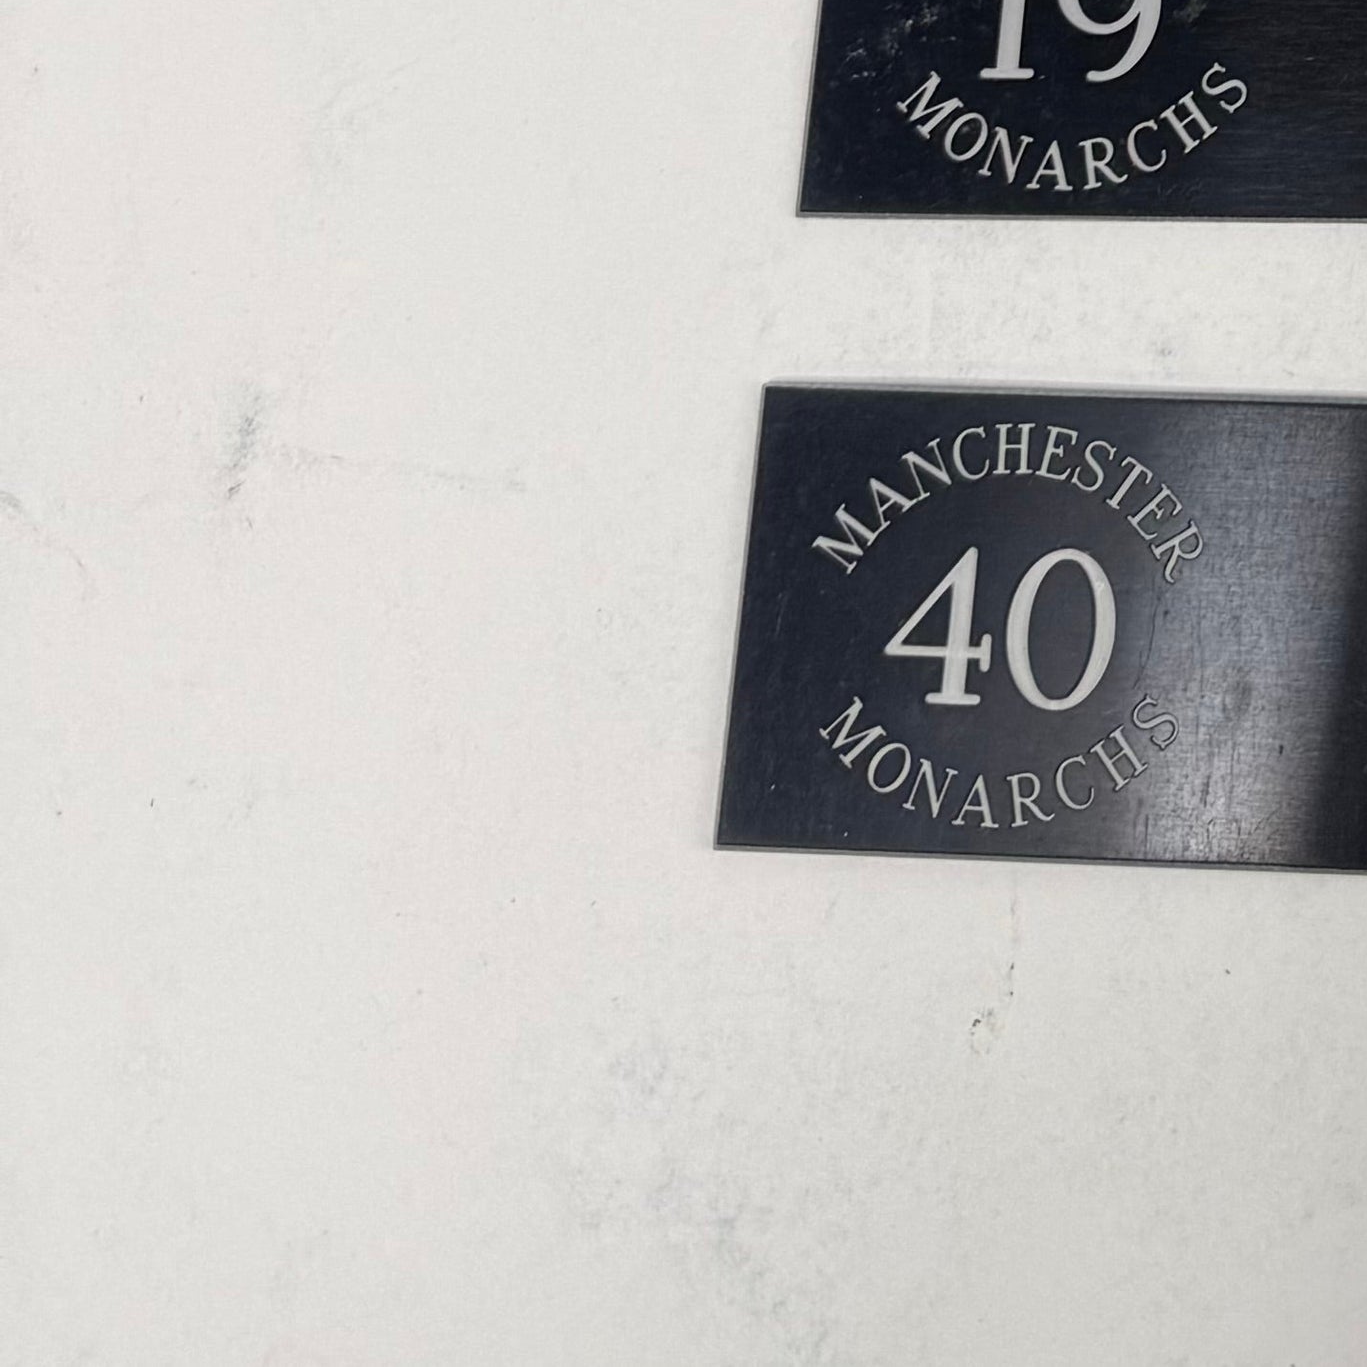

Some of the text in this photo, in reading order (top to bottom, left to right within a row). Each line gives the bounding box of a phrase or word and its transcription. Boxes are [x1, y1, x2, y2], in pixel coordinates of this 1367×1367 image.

[897, 61, 1247, 190] MONARCHS
[813, 424, 1205, 582] MANCHESTER
[884, 547, 1116, 711] 40
[820, 694, 1181, 829] MONARCHS
